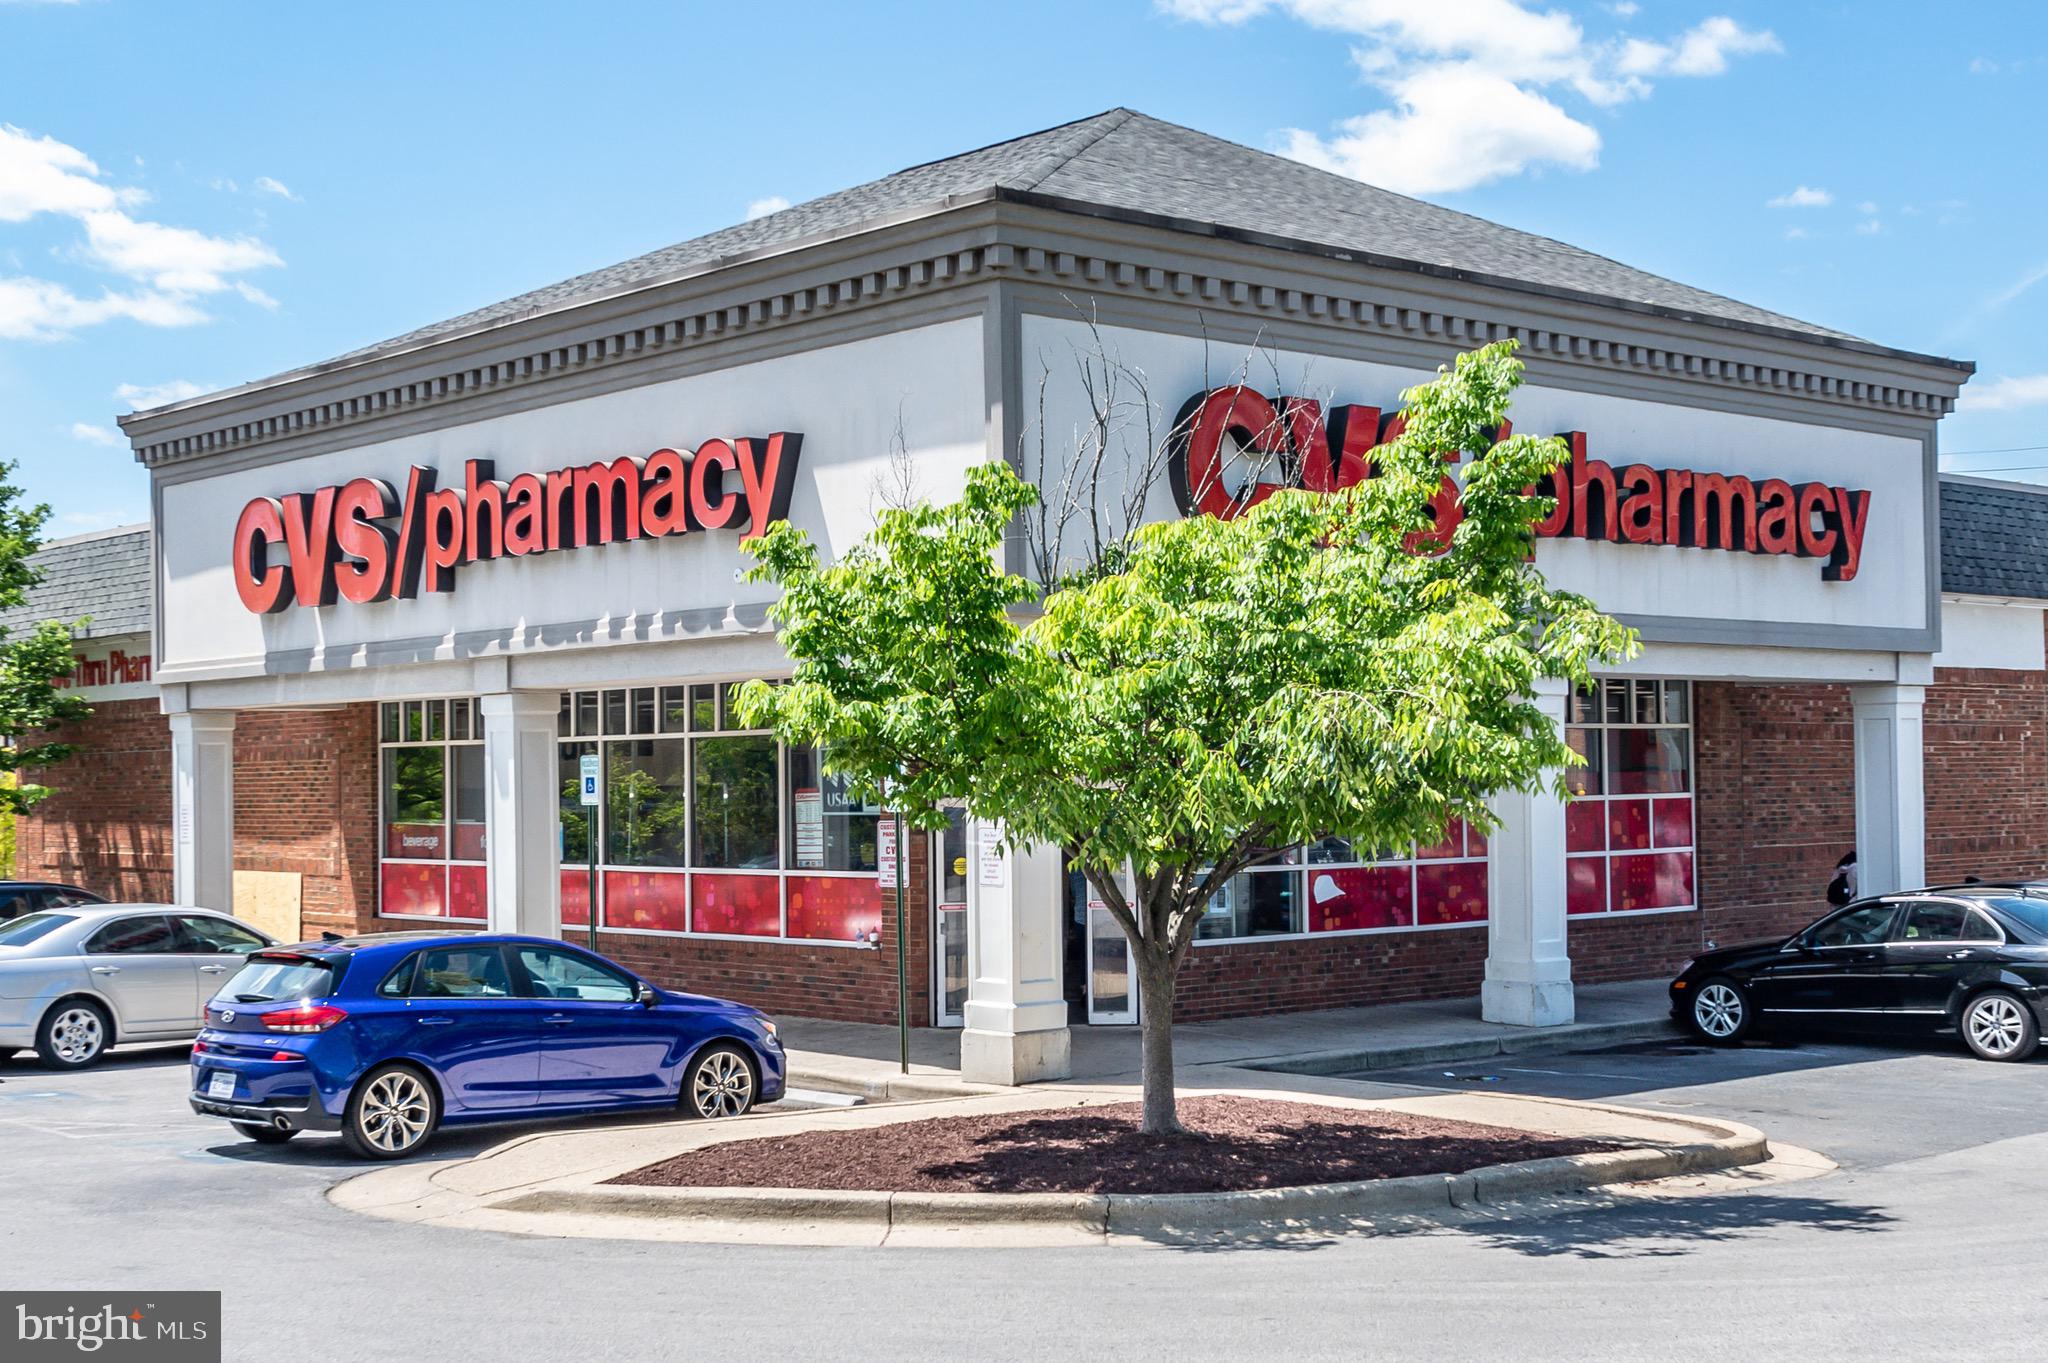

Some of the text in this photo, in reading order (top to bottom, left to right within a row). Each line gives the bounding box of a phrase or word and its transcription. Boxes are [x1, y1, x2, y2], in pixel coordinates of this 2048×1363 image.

[233, 431, 803, 614] CVS/pharmacy
[1168, 384, 1871, 581] CVSpharmacy
[402, 834, 439, 849] beverage
[827, 793, 857, 807] USAA
